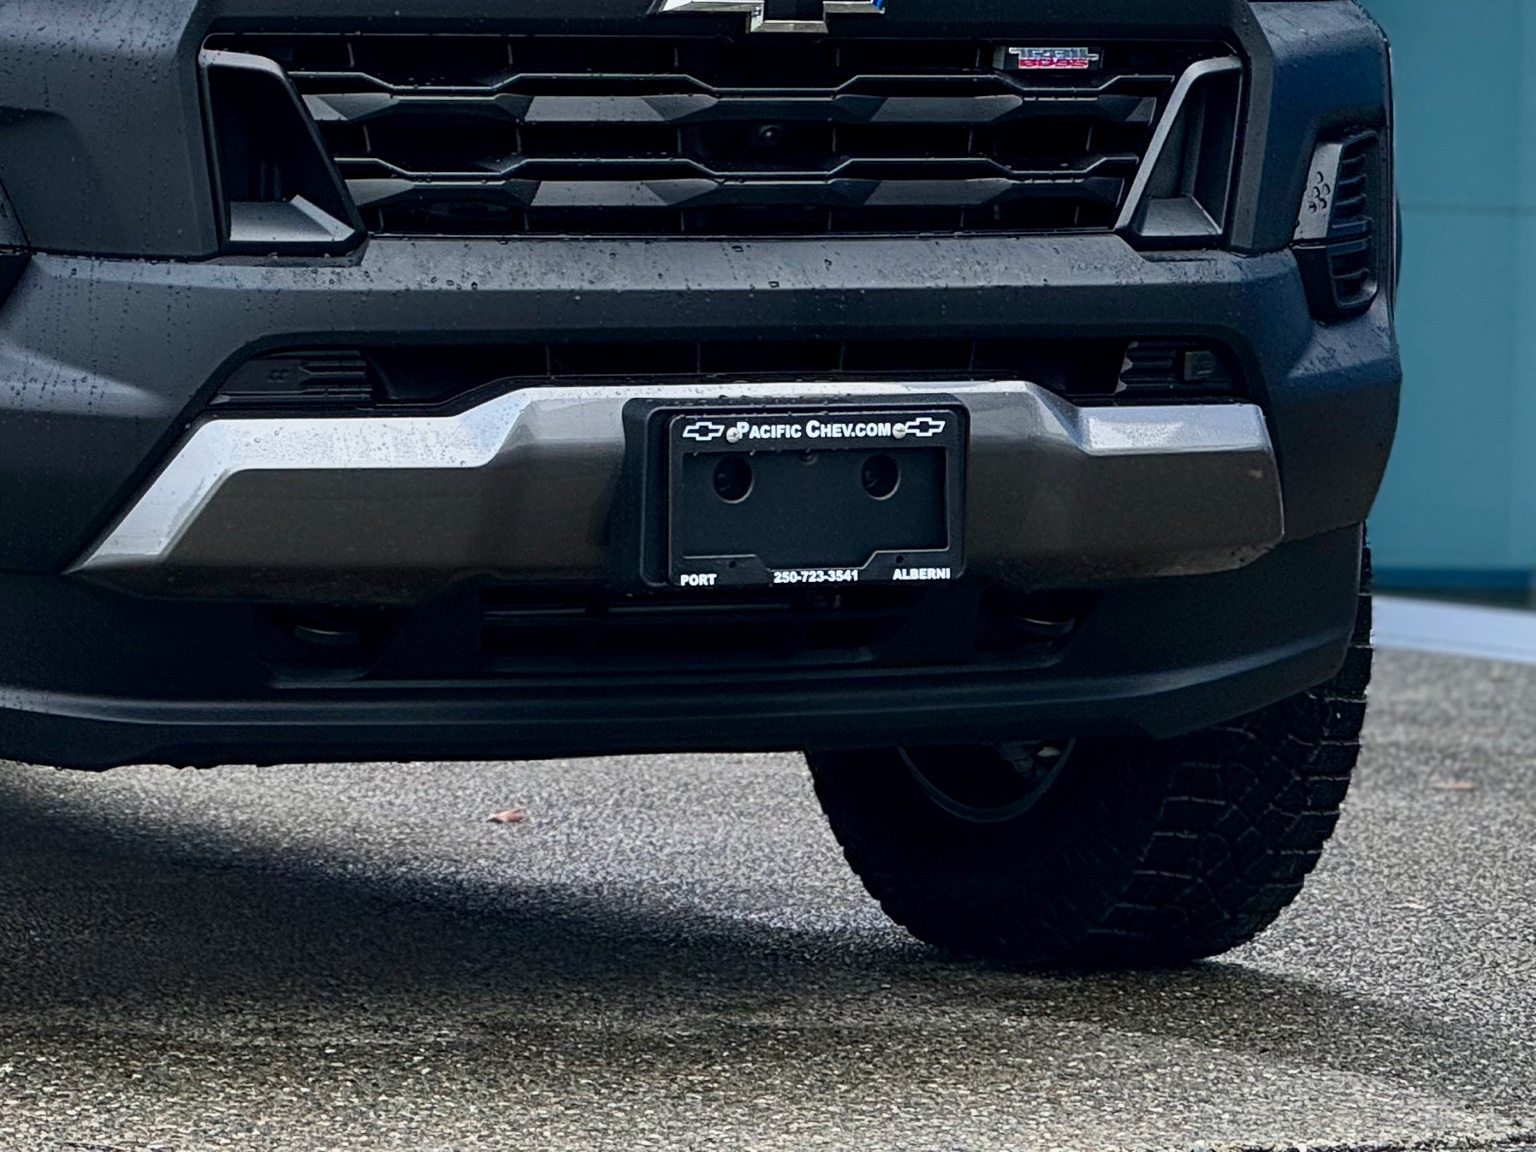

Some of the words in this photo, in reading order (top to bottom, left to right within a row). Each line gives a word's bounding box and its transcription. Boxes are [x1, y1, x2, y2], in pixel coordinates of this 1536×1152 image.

[680, 574, 717, 586] PORT
[773, 570, 859, 584] 250-723-3541
[892, 568, 951, 581] ALBERNI
